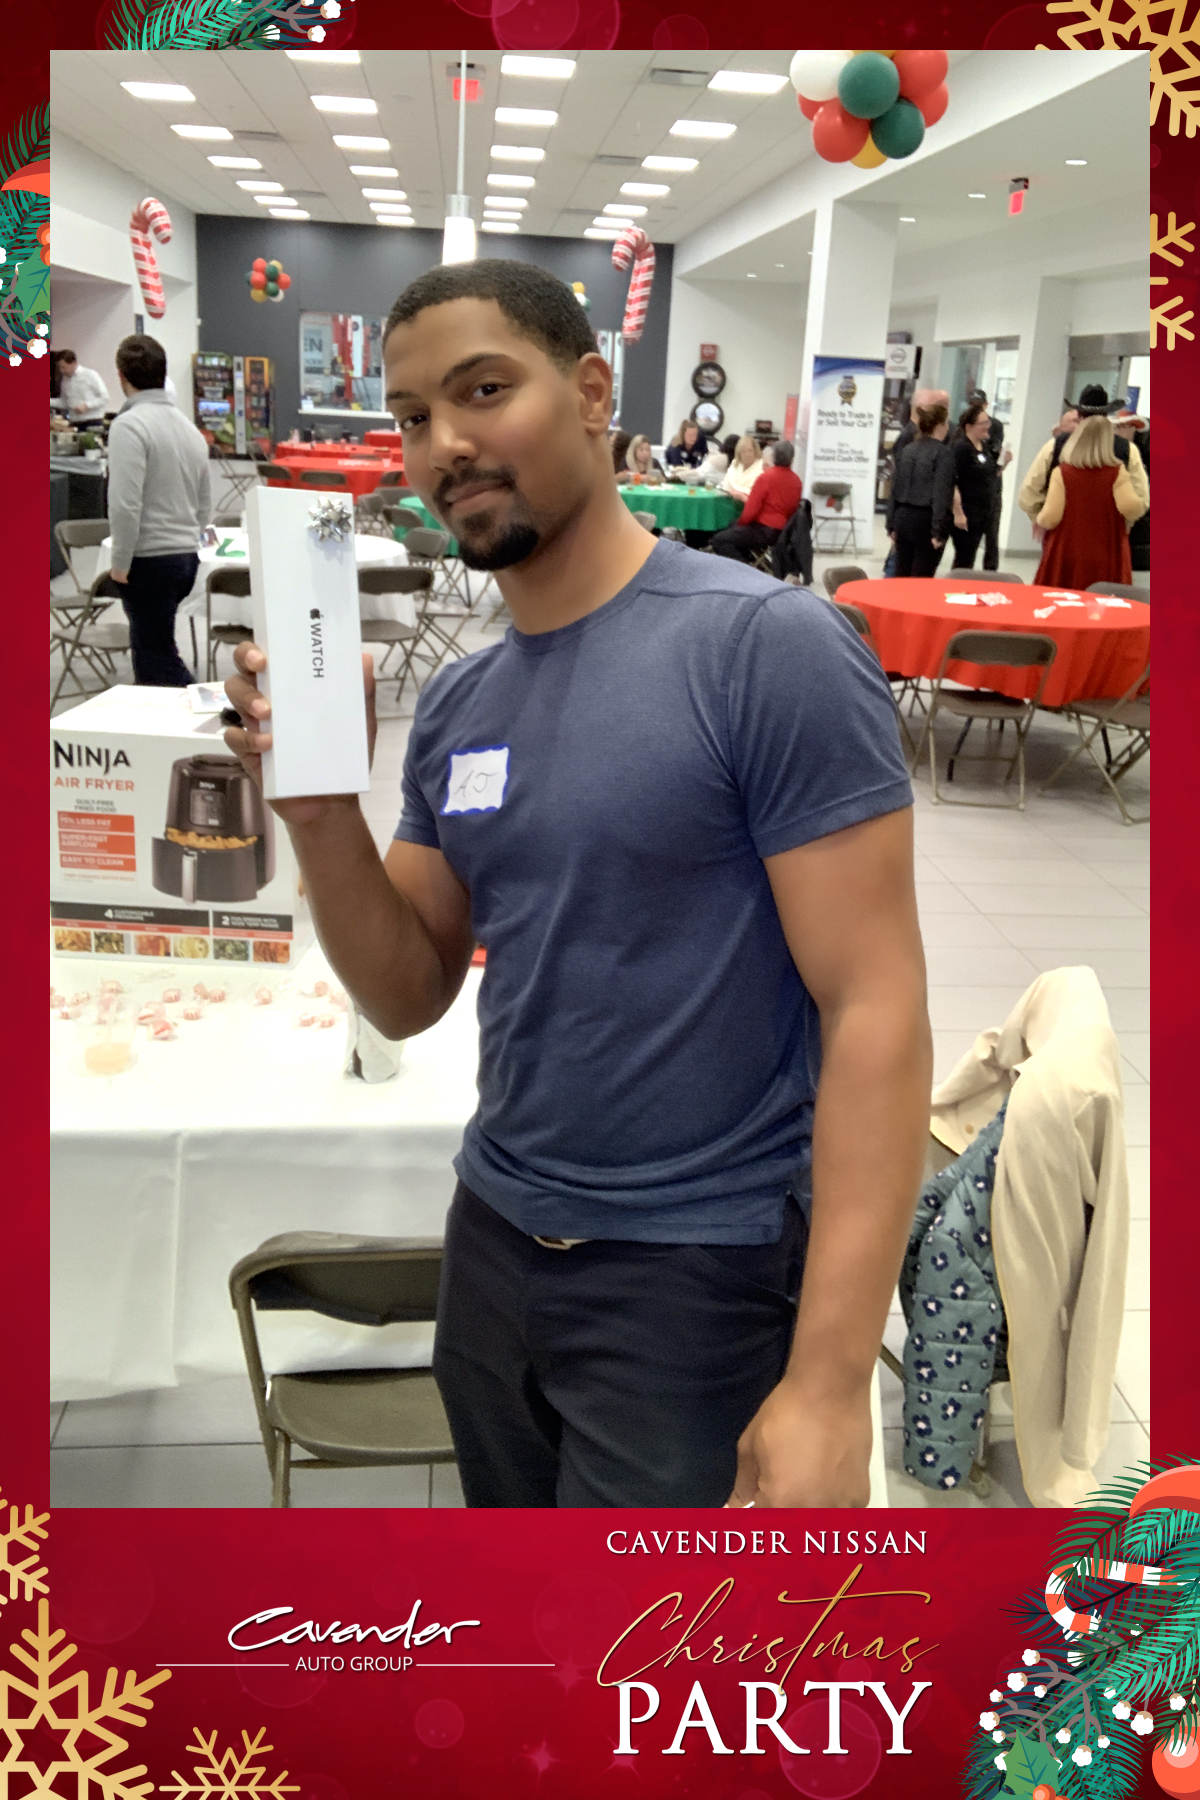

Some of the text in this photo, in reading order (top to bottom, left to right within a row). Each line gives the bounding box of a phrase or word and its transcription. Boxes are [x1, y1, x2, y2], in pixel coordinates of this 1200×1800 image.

[817, 409, 838, 418] Ready
[847, 410, 866, 419] Trade
[825, 418, 839, 426] Sell
[840, 419, 855, 427] Your
[857, 420, 873, 428] Car?
[813, 454, 870, 463] Instant Cash Offer
[311, 622, 325, 679] WATCH
[54, 740, 131, 775] NINJA
[54, 776, 134, 791] AIR FRYER
[76, 817, 96, 826] LESS
[96, 818, 112, 827] FAT
[96, 858, 124, 866] CLEAN
[103, 908, 114, 919] 4
[221, 915, 230, 926] 2
